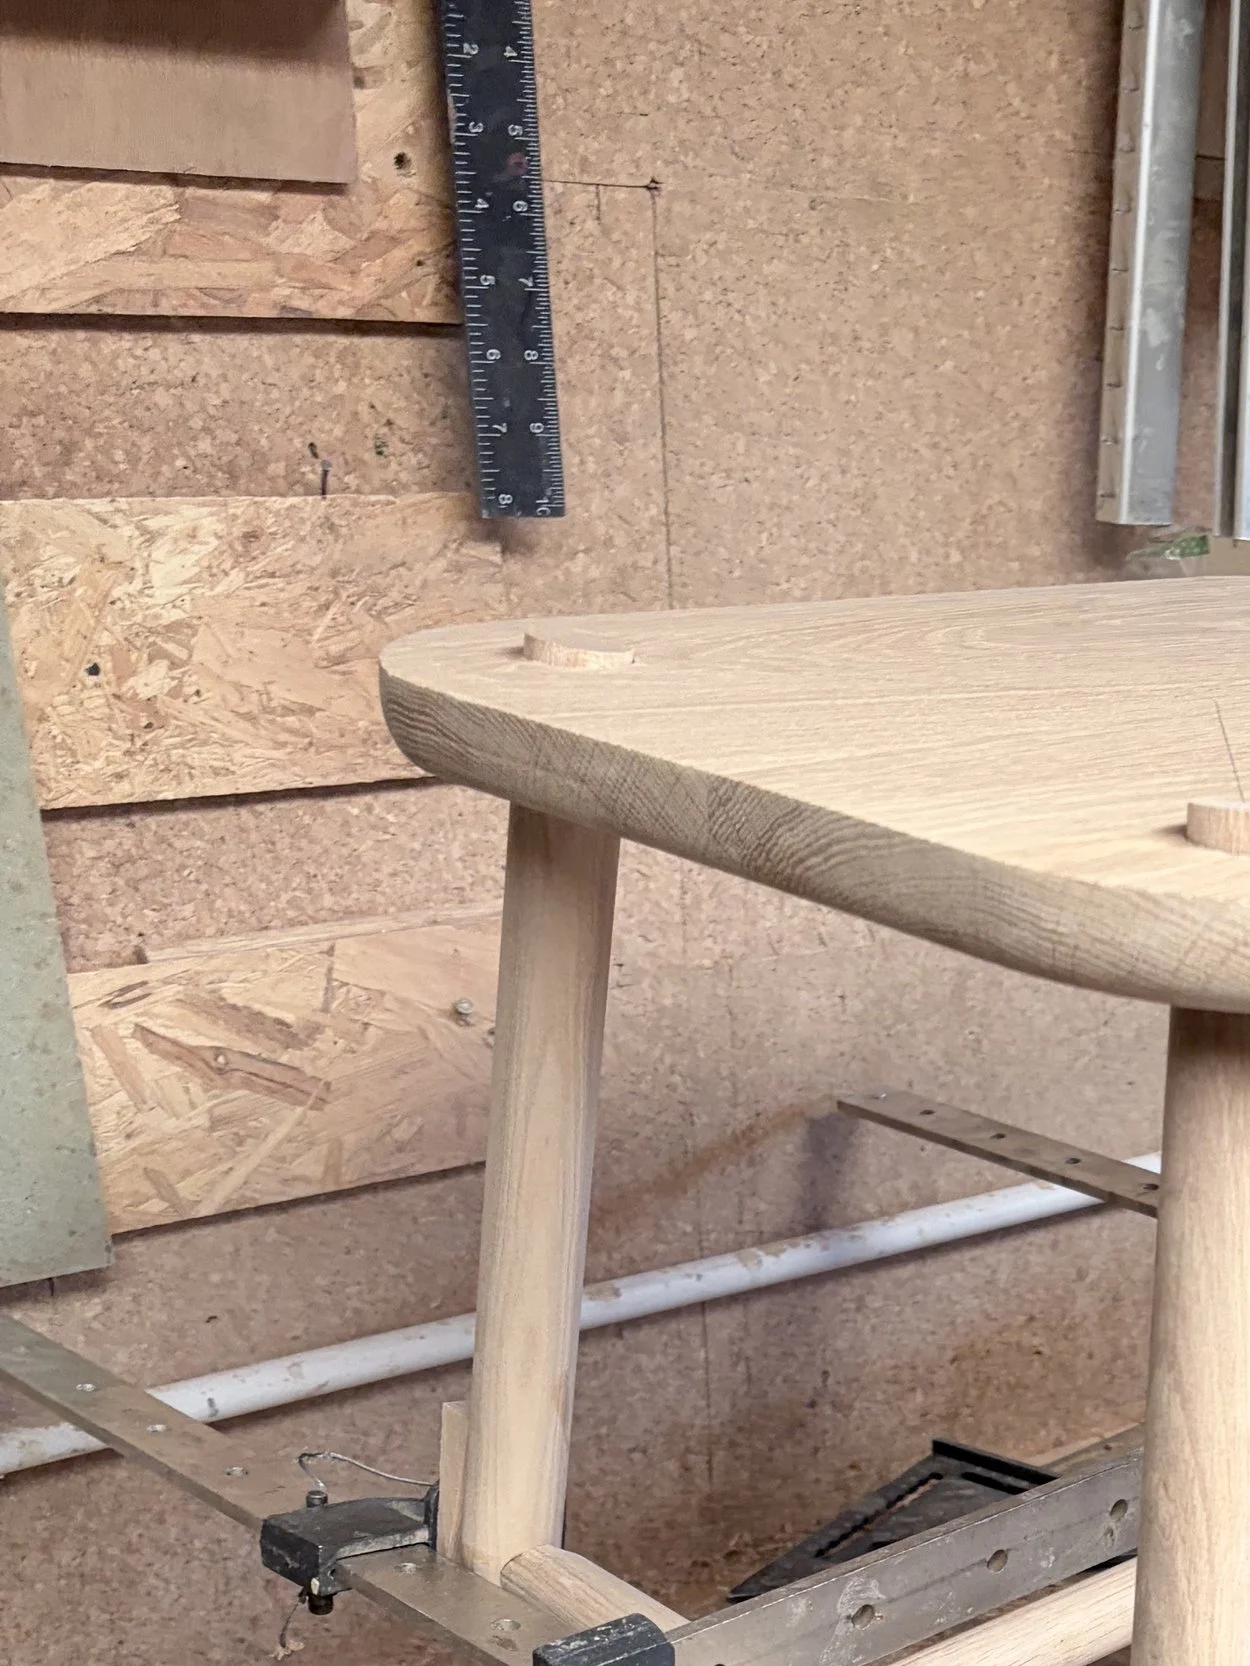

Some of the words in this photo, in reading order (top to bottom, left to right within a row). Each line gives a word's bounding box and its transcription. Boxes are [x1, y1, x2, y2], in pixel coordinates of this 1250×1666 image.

[463, 42, 479, 55] 2
[504, 46, 518, 58] 4
[469, 120, 484, 133] 3
[508, 124, 523, 136] 5
[475, 198, 490, 209] 4
[513, 200, 528, 212] 6
[480, 274, 496, 286] 5
[518, 276, 534, 288] 7
[486, 348, 502, 361] 6
[524, 350, 539, 361] 8
[492, 422, 508, 433] 7
[529, 422, 545, 434] 9
[498, 494, 514, 505] 8
